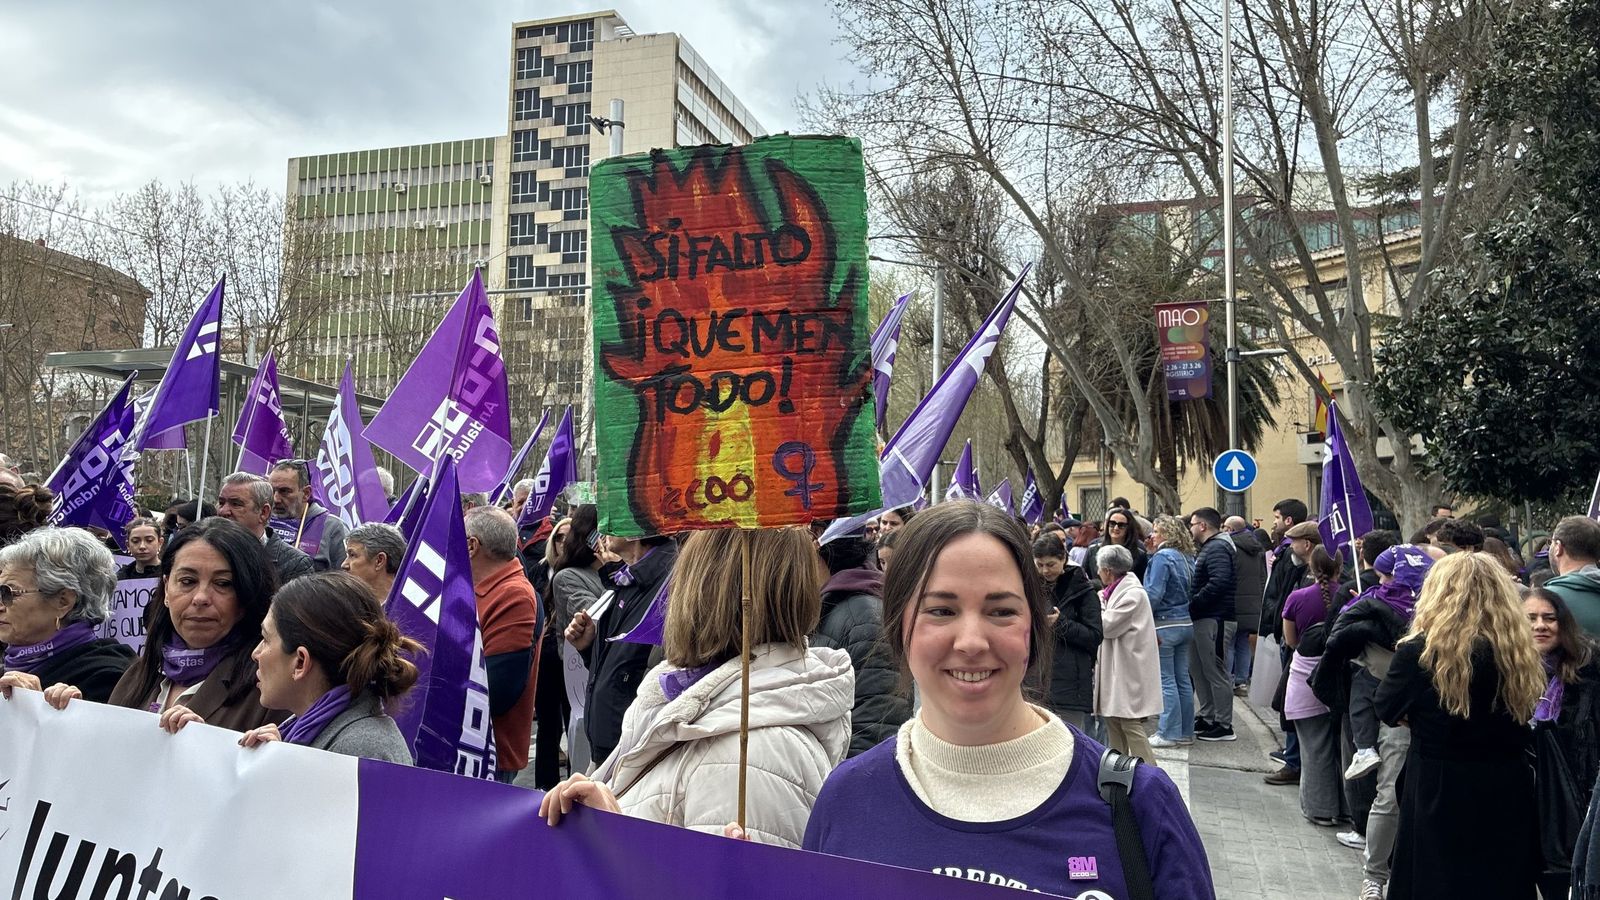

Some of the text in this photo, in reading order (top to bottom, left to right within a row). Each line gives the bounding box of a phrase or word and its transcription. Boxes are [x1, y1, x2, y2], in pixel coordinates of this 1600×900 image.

[1158, 308, 1200, 327] MAO
[1308, 353, 1336, 366] DELE
[635, 356, 795, 422] TODO!
[1068, 857, 1098, 871] 8M
